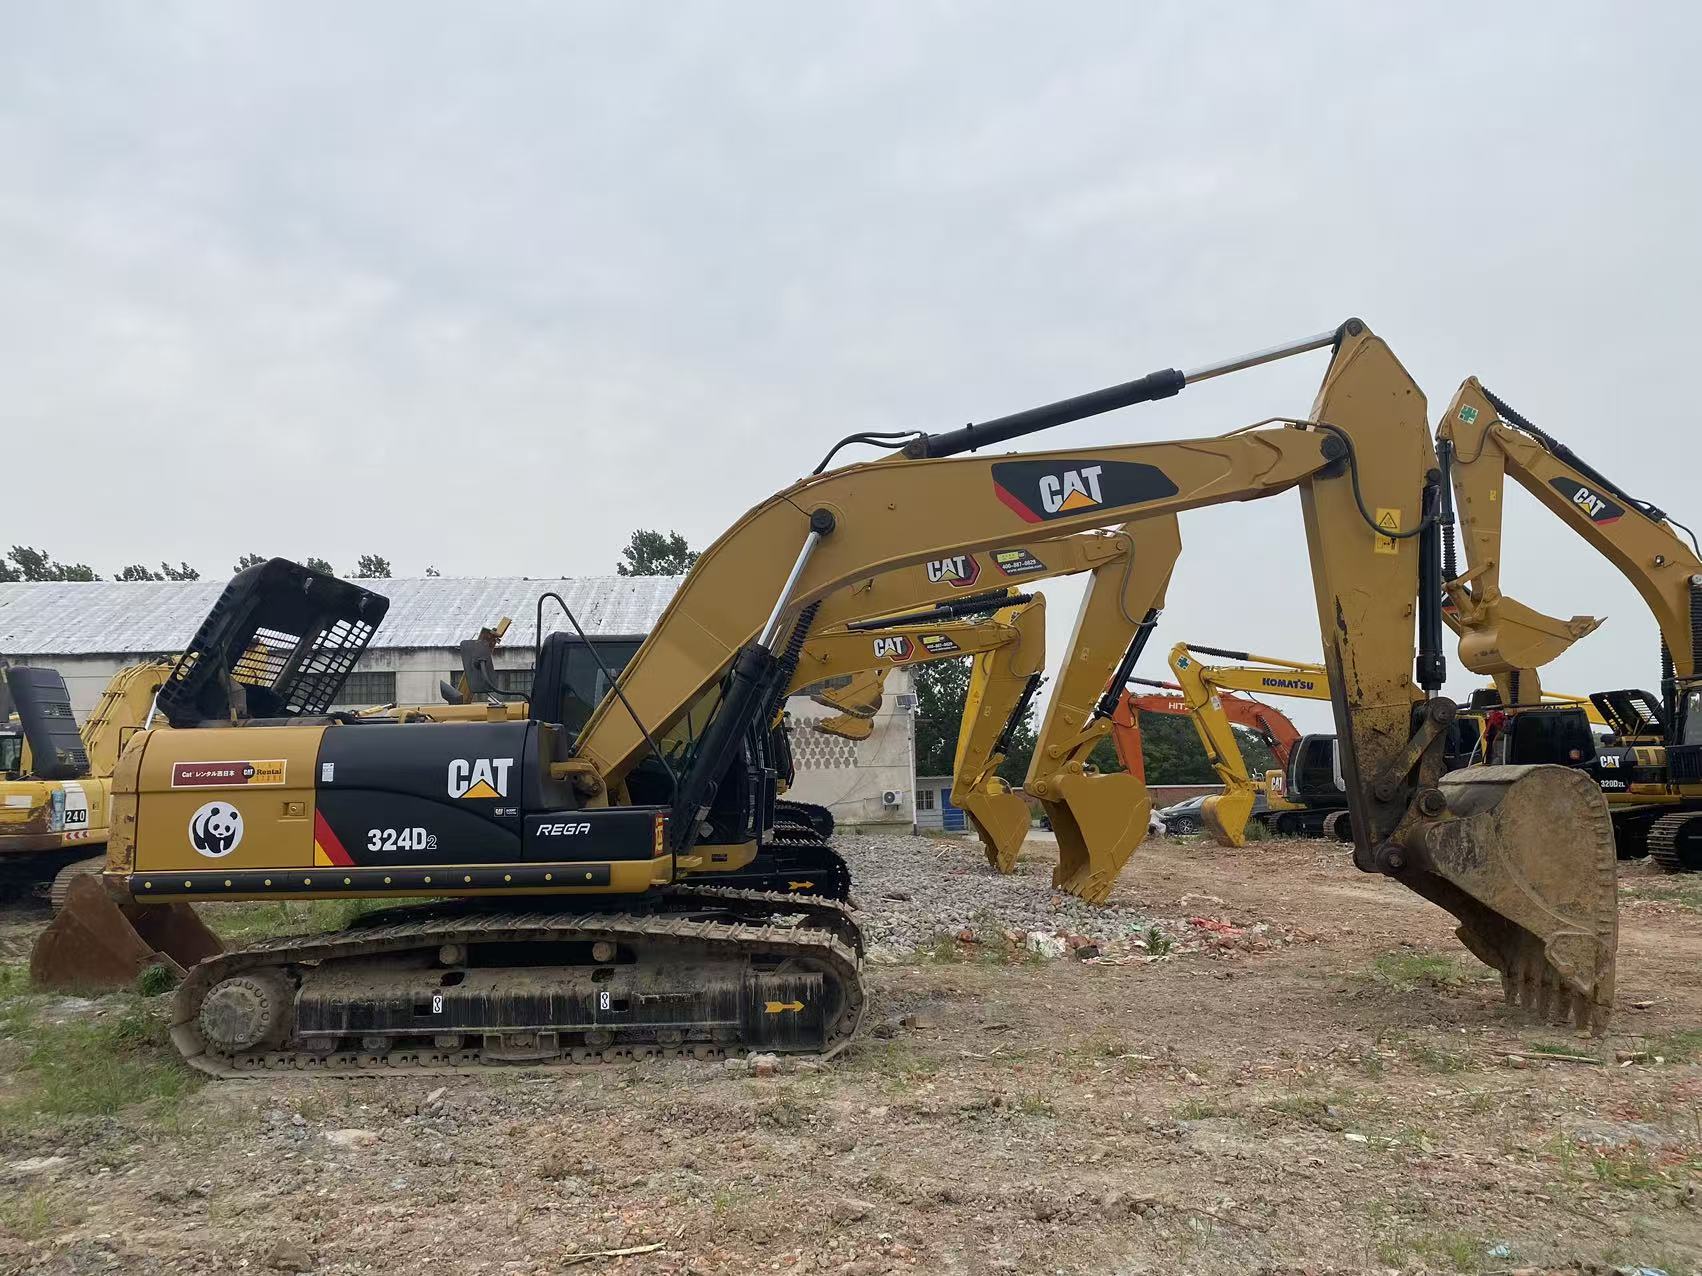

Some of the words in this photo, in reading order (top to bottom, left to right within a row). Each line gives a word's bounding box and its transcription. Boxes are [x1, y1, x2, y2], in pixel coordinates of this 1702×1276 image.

[1038, 465, 1103, 514] CAT
[1573, 488, 1606, 517] CAT
[926, 555, 966, 582] CAT
[874, 636, 904, 658] CAT
[1262, 677, 1314, 690] KOMATSU
[1168, 701, 1188, 711] HIT
[1600, 755, 1620, 768] CAT
[257, 768, 282, 776] Rental
[447, 758, 514, 799] CAT
[66, 810, 85, 823] 240
[536, 822, 591, 837] REGA
[367, 827, 438, 852] 324D2
